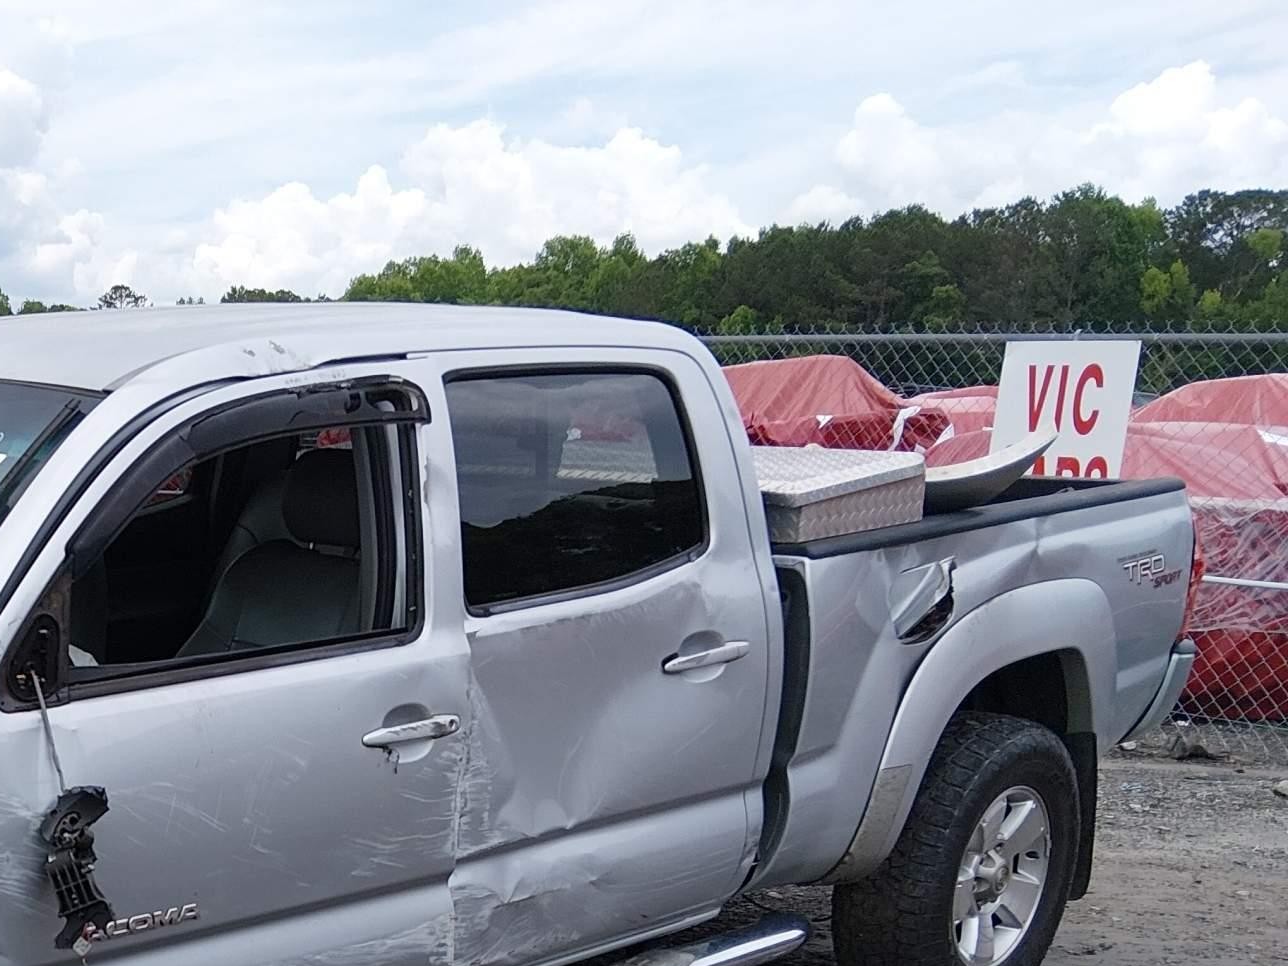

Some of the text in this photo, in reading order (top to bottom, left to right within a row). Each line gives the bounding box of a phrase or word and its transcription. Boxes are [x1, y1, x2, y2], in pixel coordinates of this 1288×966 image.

[1028, 363, 1104, 436] VIC
[1123, 554, 1165, 586] TRD
[1153, 569, 1183, 588] SPORT
